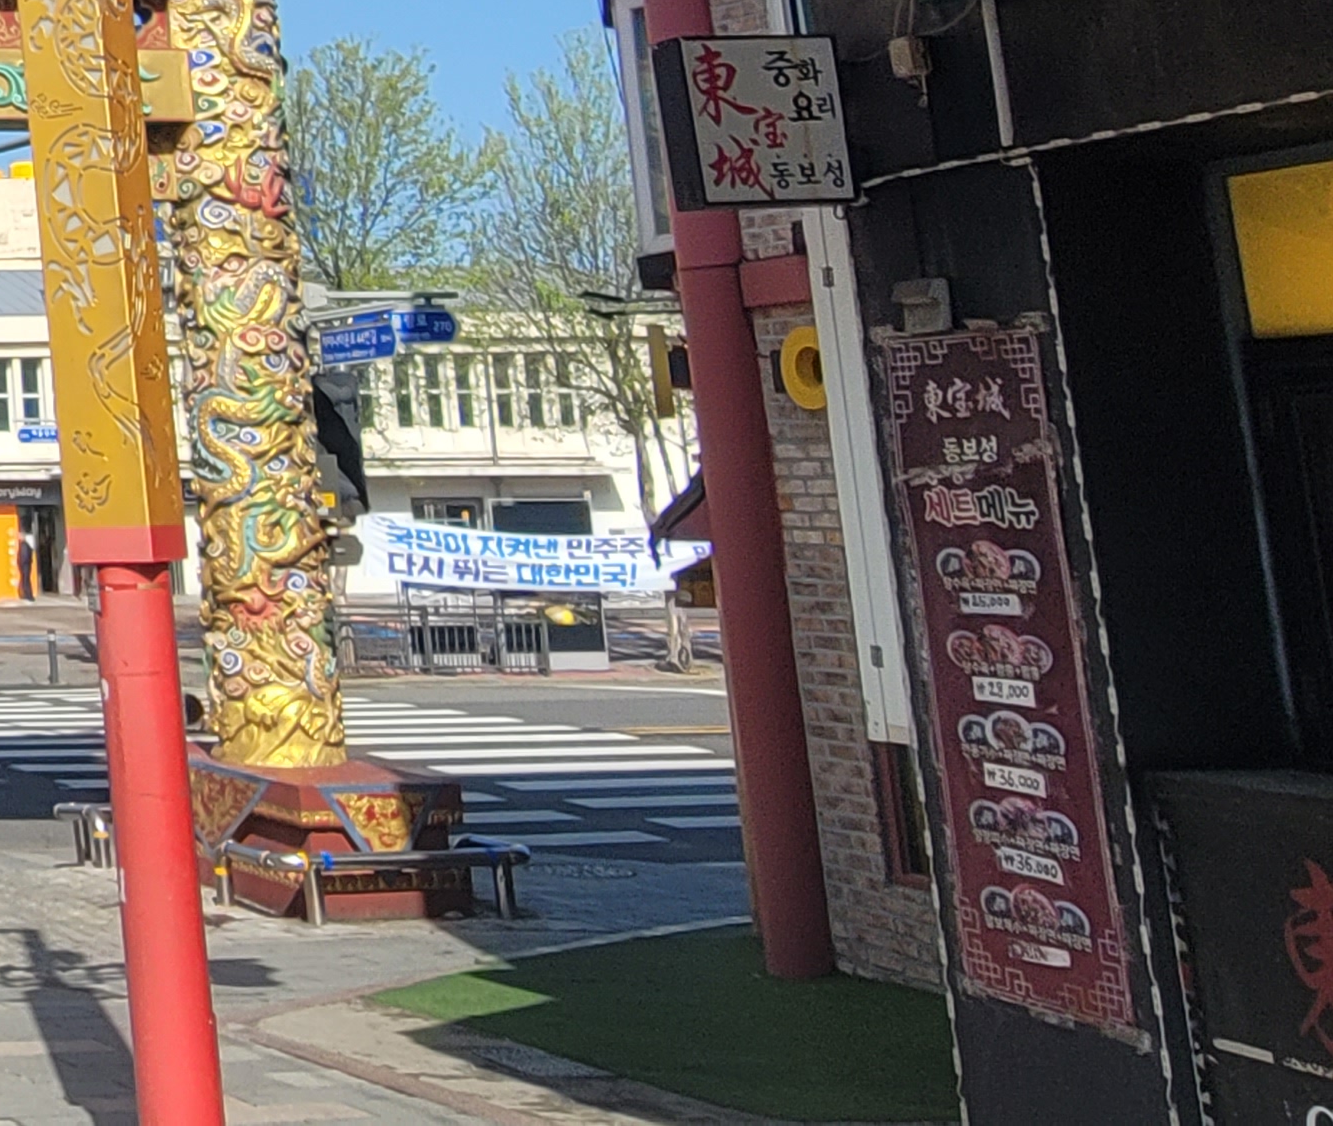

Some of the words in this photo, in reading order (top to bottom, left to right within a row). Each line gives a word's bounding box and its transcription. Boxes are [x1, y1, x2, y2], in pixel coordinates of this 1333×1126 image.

[761, 49, 822, 89] 중화
[788, 90, 836, 124] 요리
[768, 153, 847, 189] 동보성
[941, 434, 999, 464] 동보성
[923, 484, 1040, 531] 세트메뉴
[387, 526, 472, 556] 국민이
[479, 534, 558, 561] 지켜낸
[388, 552, 445, 580] 다시
[452, 559, 509, 585] 뛰는
[516, 562, 638, 588] 대한민국!
